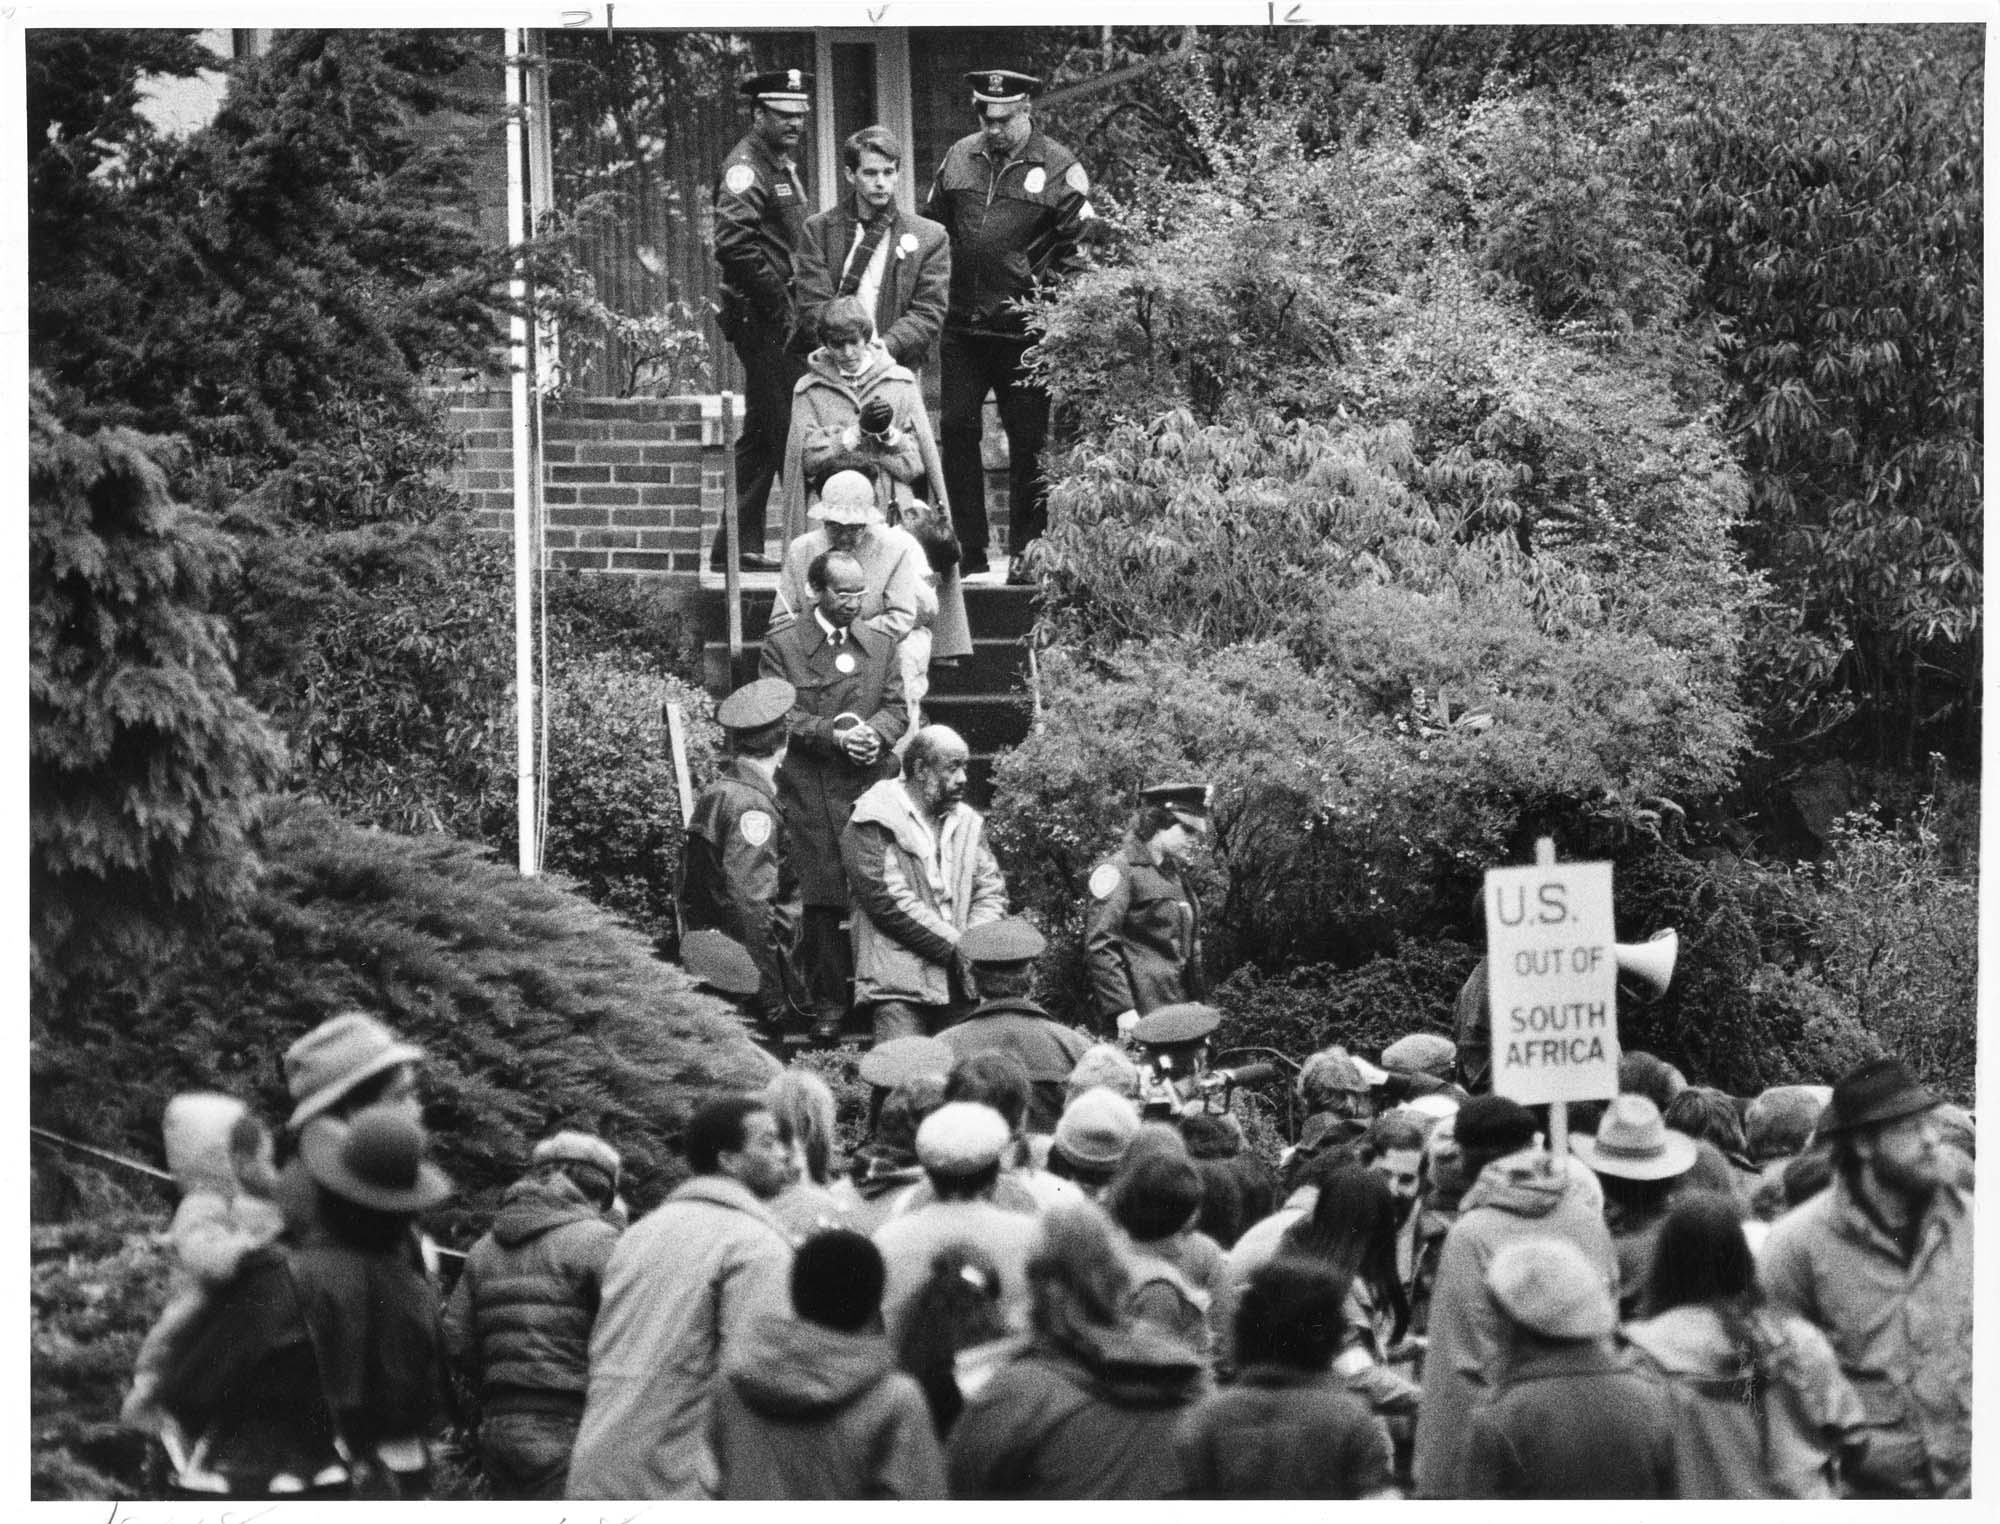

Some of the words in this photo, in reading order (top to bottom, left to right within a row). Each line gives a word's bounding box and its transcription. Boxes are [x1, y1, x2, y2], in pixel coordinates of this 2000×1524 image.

[1497, 883, 1578, 926] U.S.
[1515, 948, 1562, 976] OUT
[1571, 946, 1605, 973] OF
[1510, 1002, 1606, 1033] SOUTH
[1506, 1037, 1605, 1067] AFRICA
